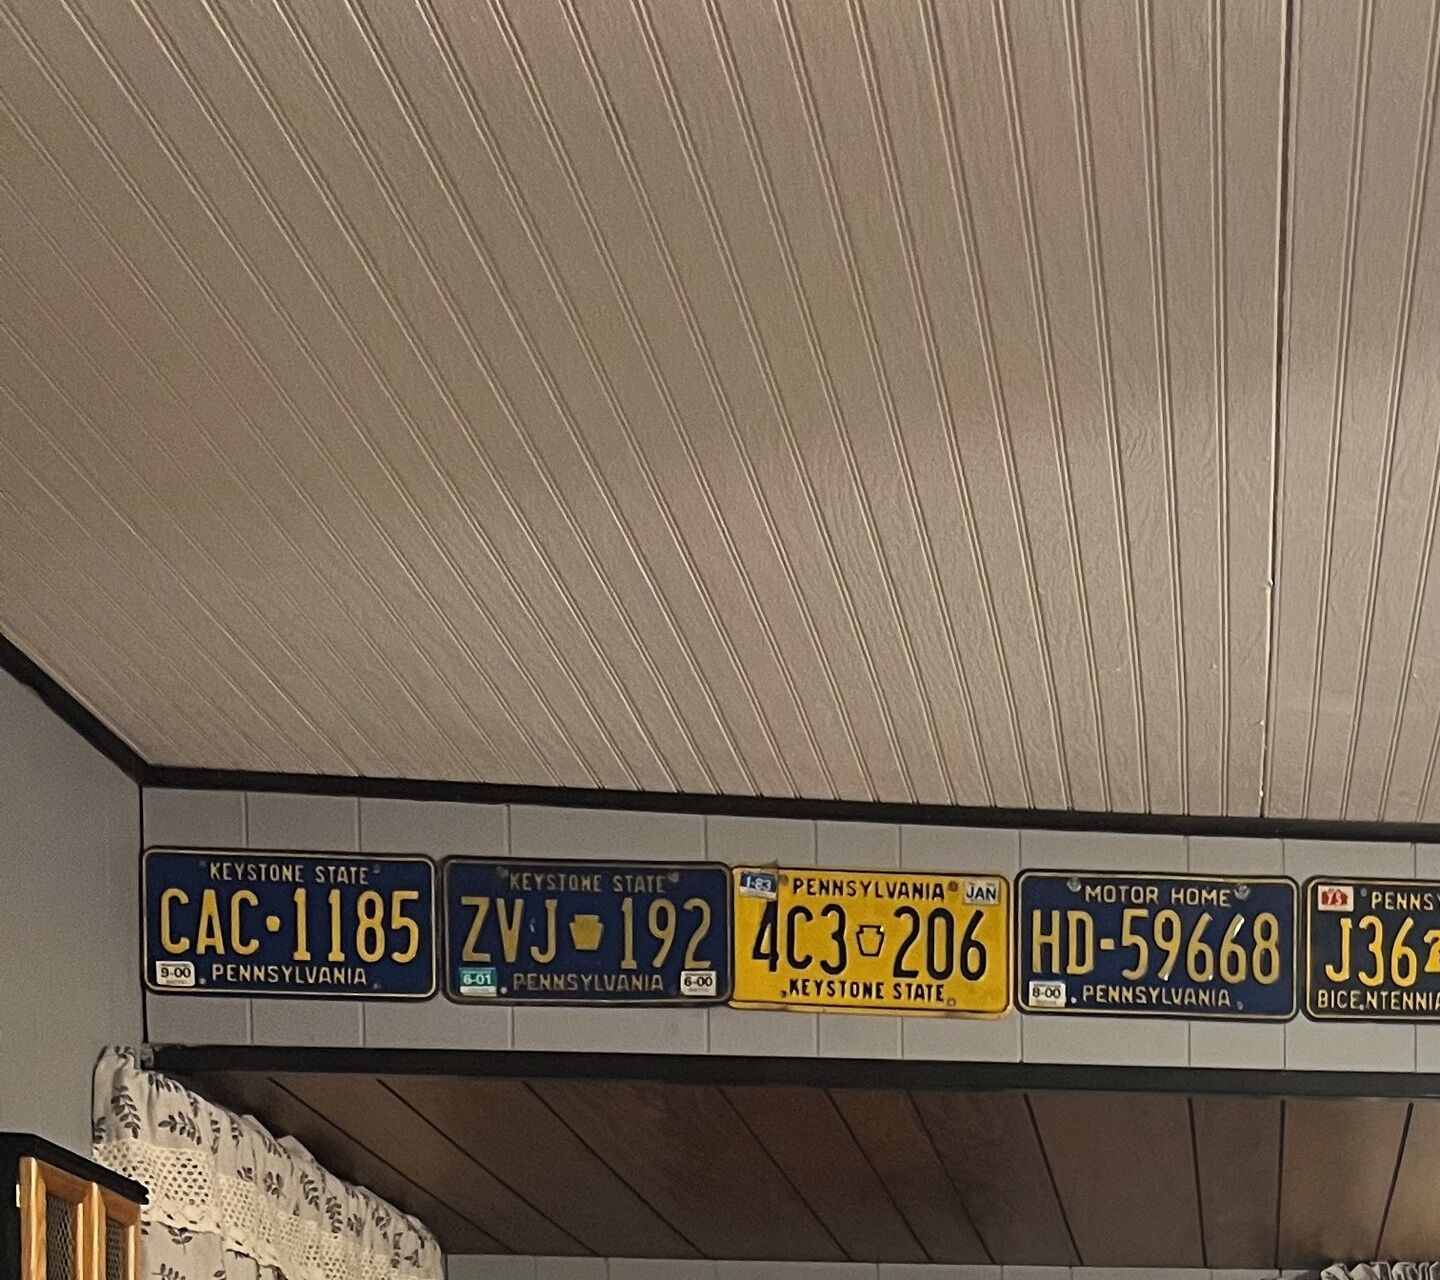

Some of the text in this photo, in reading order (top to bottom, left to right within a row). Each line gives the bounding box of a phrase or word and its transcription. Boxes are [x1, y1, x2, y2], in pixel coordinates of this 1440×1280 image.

[210, 862, 369, 885] KEYSTONE STATE
[509, 872, 667, 894] KEYSTONE STATE
[792, 877, 946, 901] PENNSYLVANIA
[966, 886, 997, 900] JAN
[1084, 885, 1232, 908] MOTOR HOME
[460, 895, 713, 970] ZVJ 192
[752, 900, 987, 981] 4C3 206
[1032, 908, 1280, 985] HD-59668
[1325, 915, 1418, 988] J36
[161, 967, 191, 978] 9-00
[212, 963, 368, 985] PENNSYLVANIA
[463, 974, 492, 985] 6-01
[513, 972, 664, 993] PENNSYLVANIA
[684, 976, 713, 987] 6-00
[789, 978, 945, 1003] KEYSTONE STATE
[1082, 985, 1232, 1008] PENNSYLVANIA
